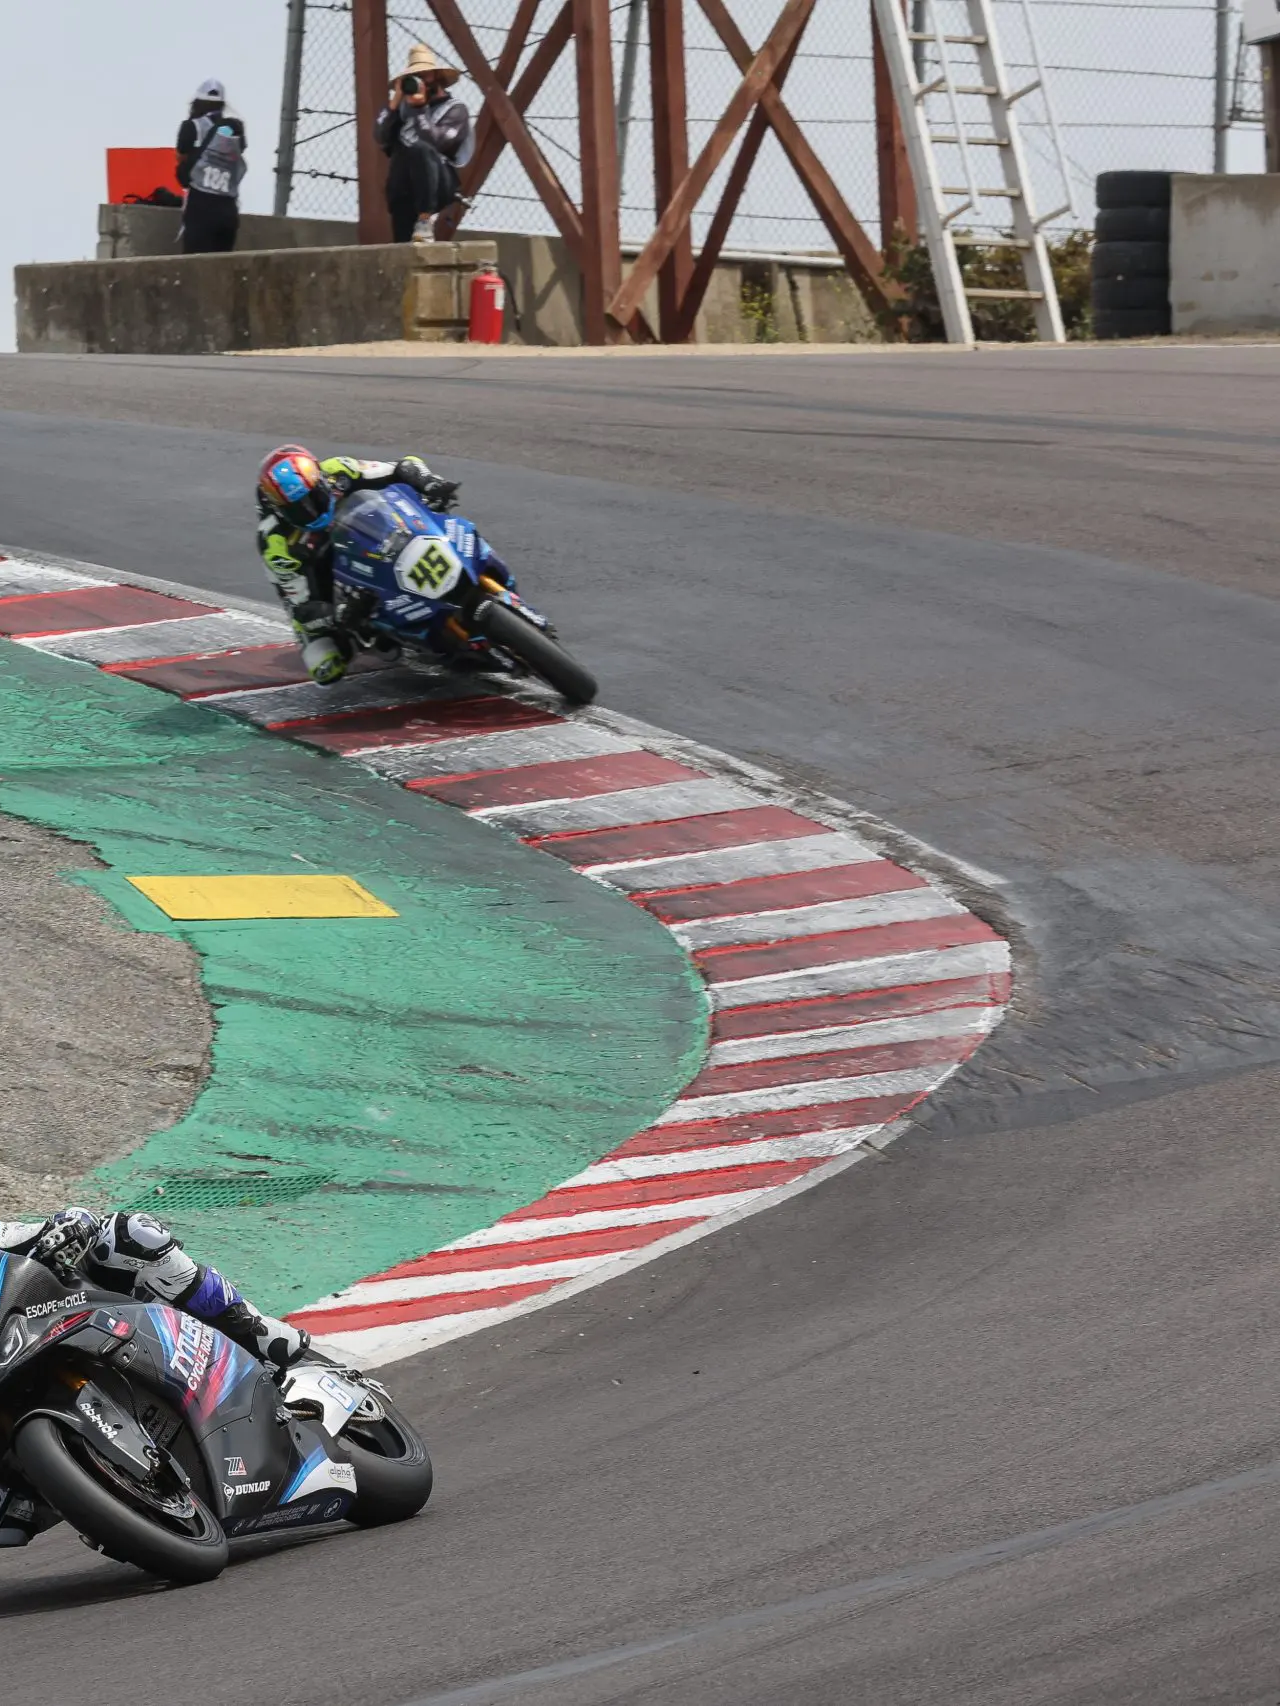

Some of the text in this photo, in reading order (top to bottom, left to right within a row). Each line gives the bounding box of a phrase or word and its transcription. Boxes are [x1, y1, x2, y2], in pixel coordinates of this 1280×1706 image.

[407, 543, 451, 590] 45
[26, 1300, 57, 1319] ESCAPE
[65, 1291, 87, 1308] CYCLE
[187, 1351, 209, 1391] CYCLE
[80, 1403, 117, 1439] DUNLOP
[330, 1465, 351, 1477] alpha
[235, 1480, 271, 1495] DUNLOP
